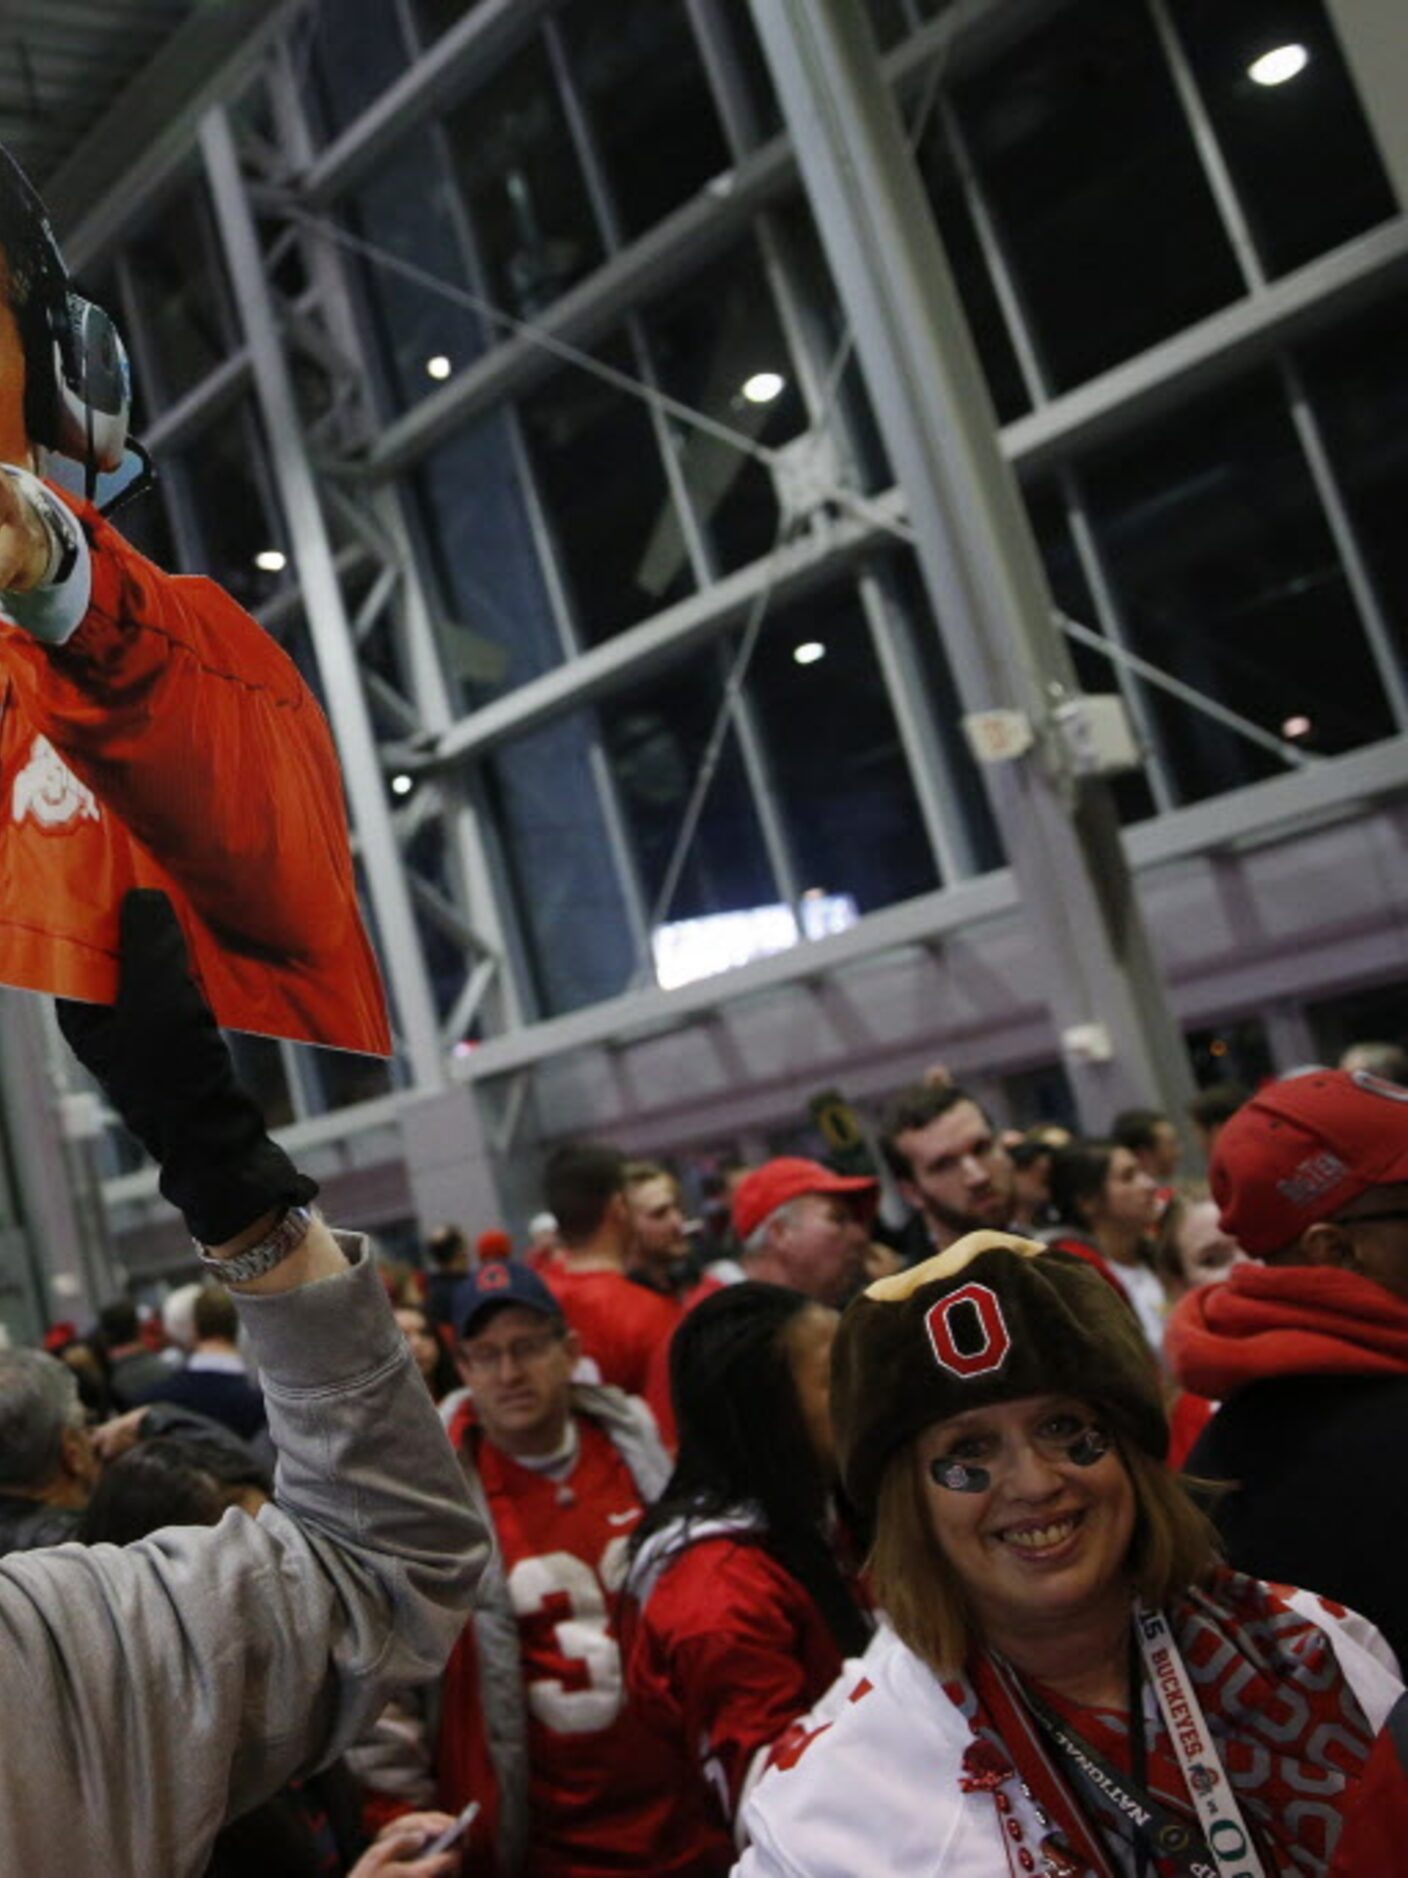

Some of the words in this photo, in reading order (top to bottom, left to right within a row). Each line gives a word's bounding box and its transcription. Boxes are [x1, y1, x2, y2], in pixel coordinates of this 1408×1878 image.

[923, 1281, 1010, 1378] O
[1151, 1648, 1204, 1758] BUCKEYES
[1054, 1731, 1152, 1827] NATIONAL
